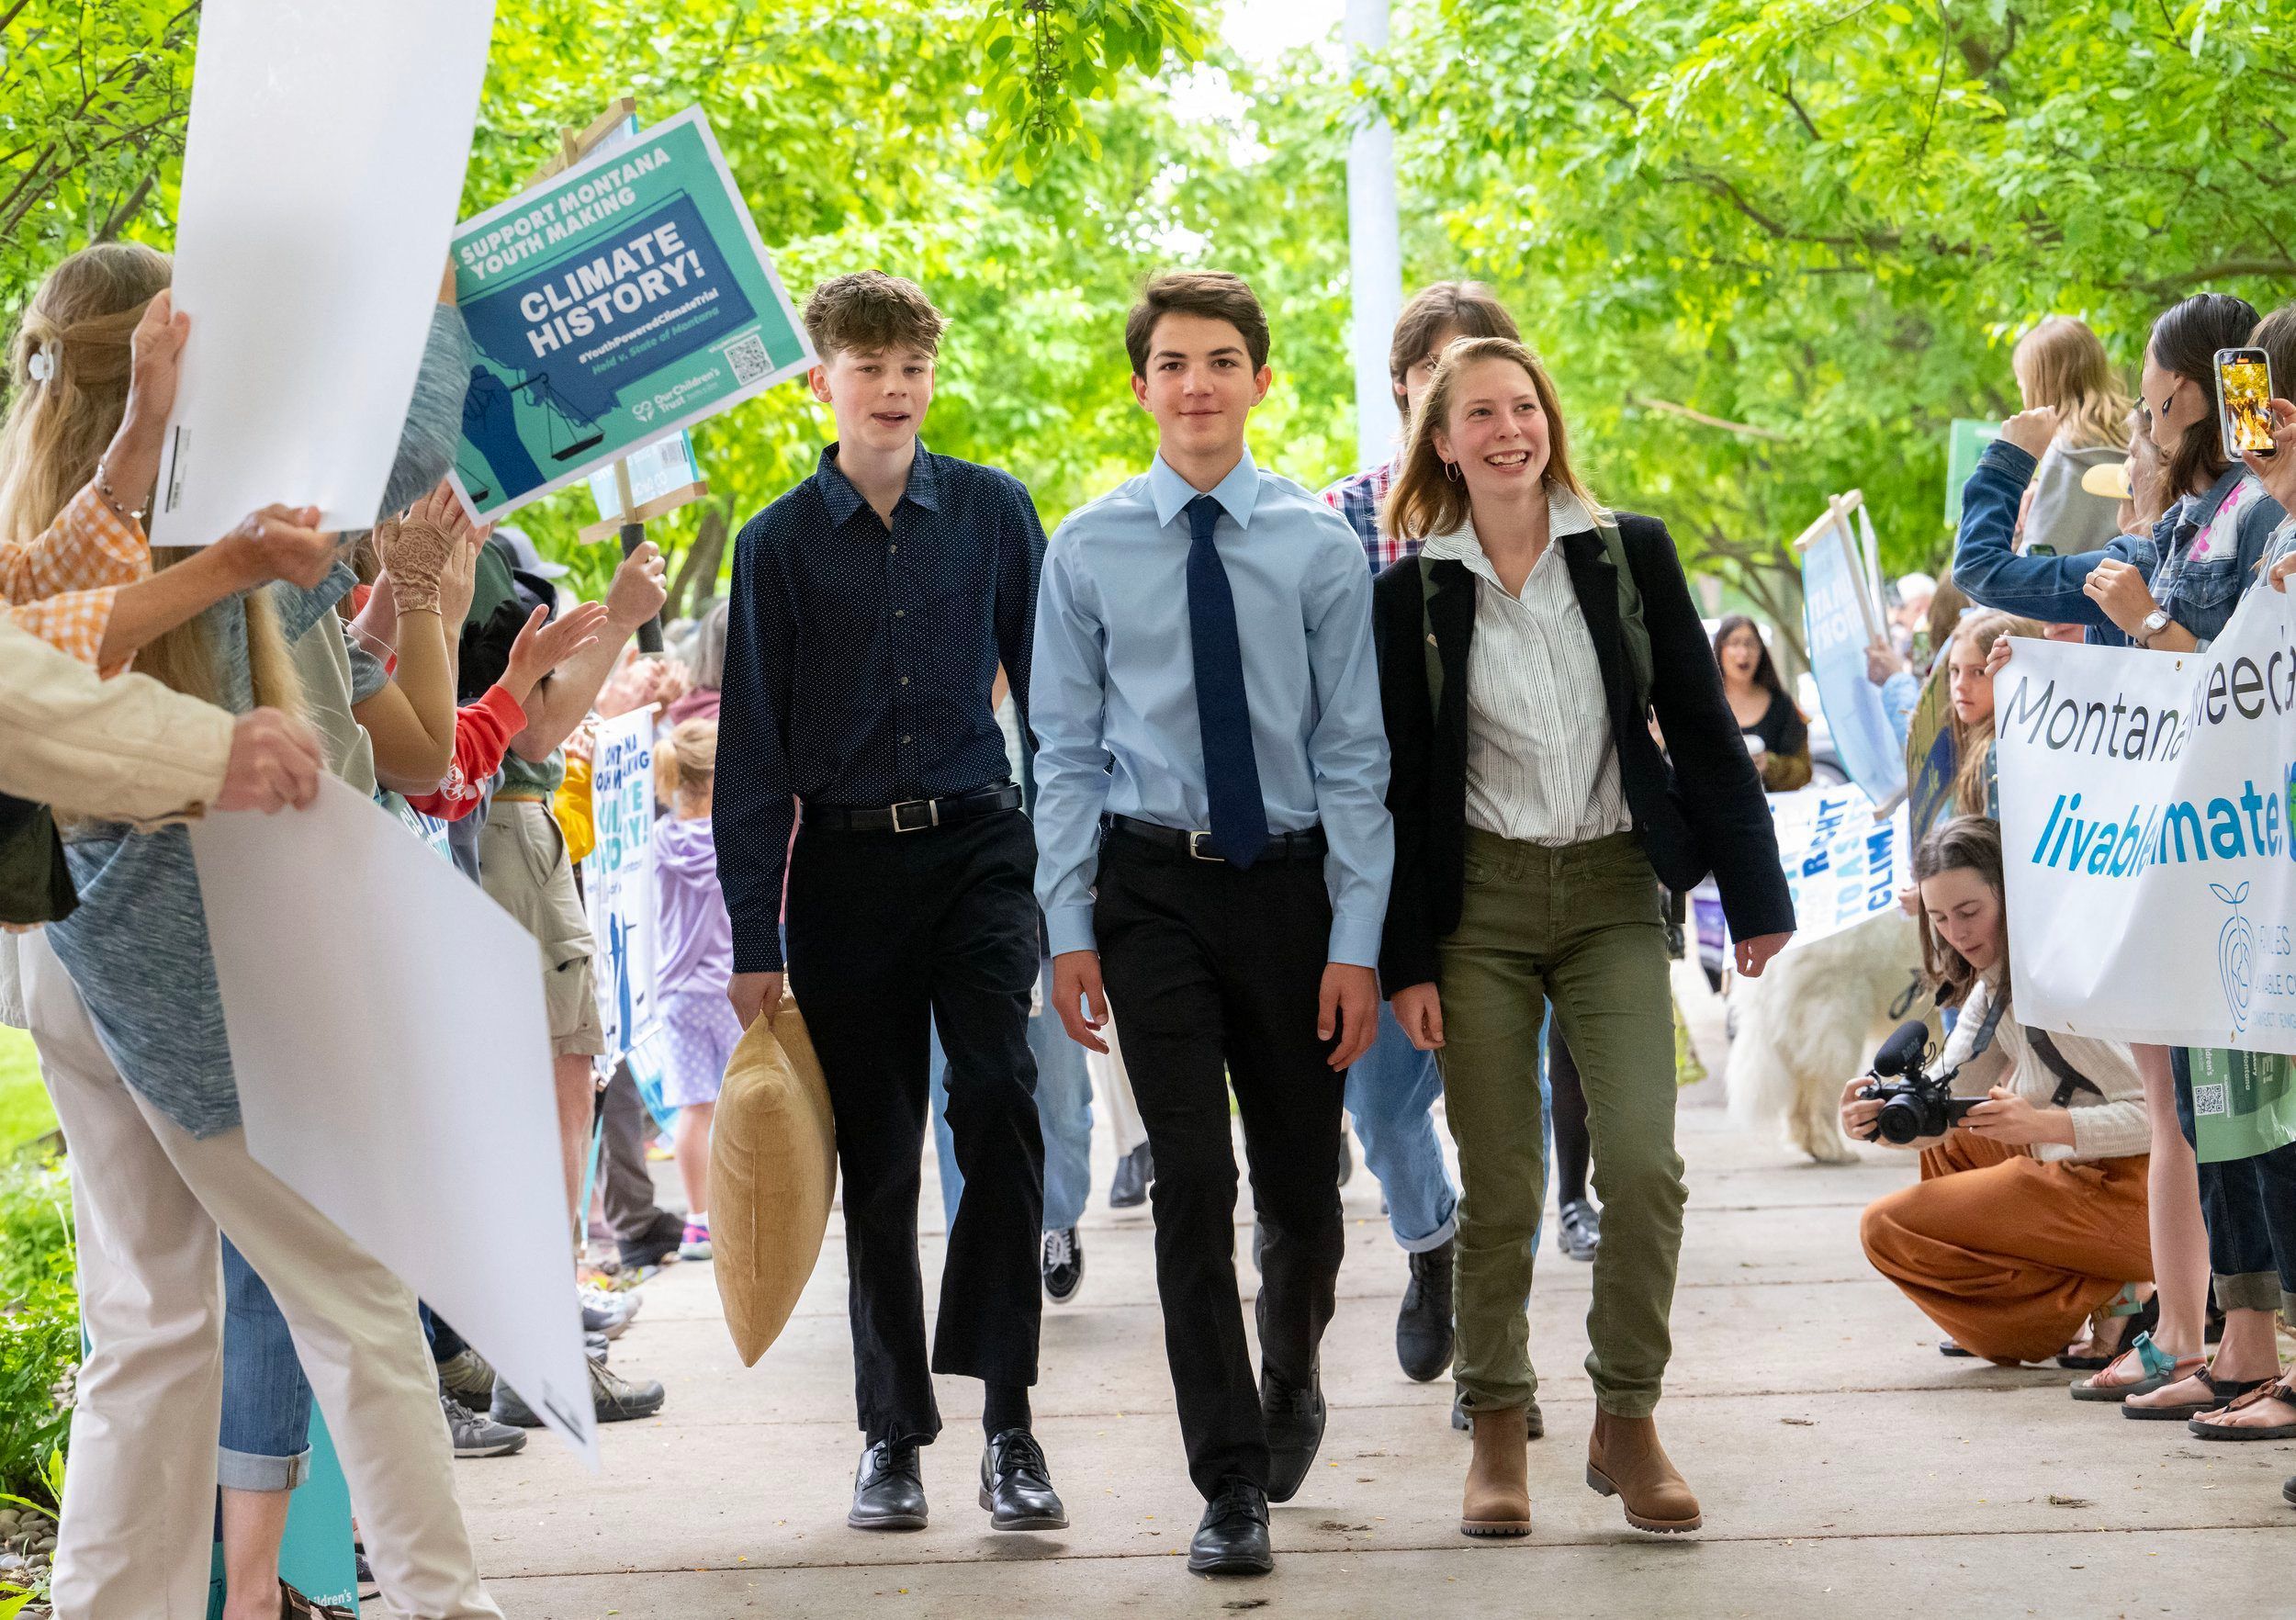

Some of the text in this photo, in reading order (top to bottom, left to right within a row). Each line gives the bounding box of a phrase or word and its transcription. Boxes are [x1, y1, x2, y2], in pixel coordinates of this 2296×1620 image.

[461, 148, 671, 264] SUPPORT MONTANA
[470, 186, 636, 280] YOUTH MAKING
[520, 221, 686, 322] CLIMATE
[525, 249, 706, 358] HISTORY!
[579, 287, 719, 364] #YouthPoweredClimateTrial
